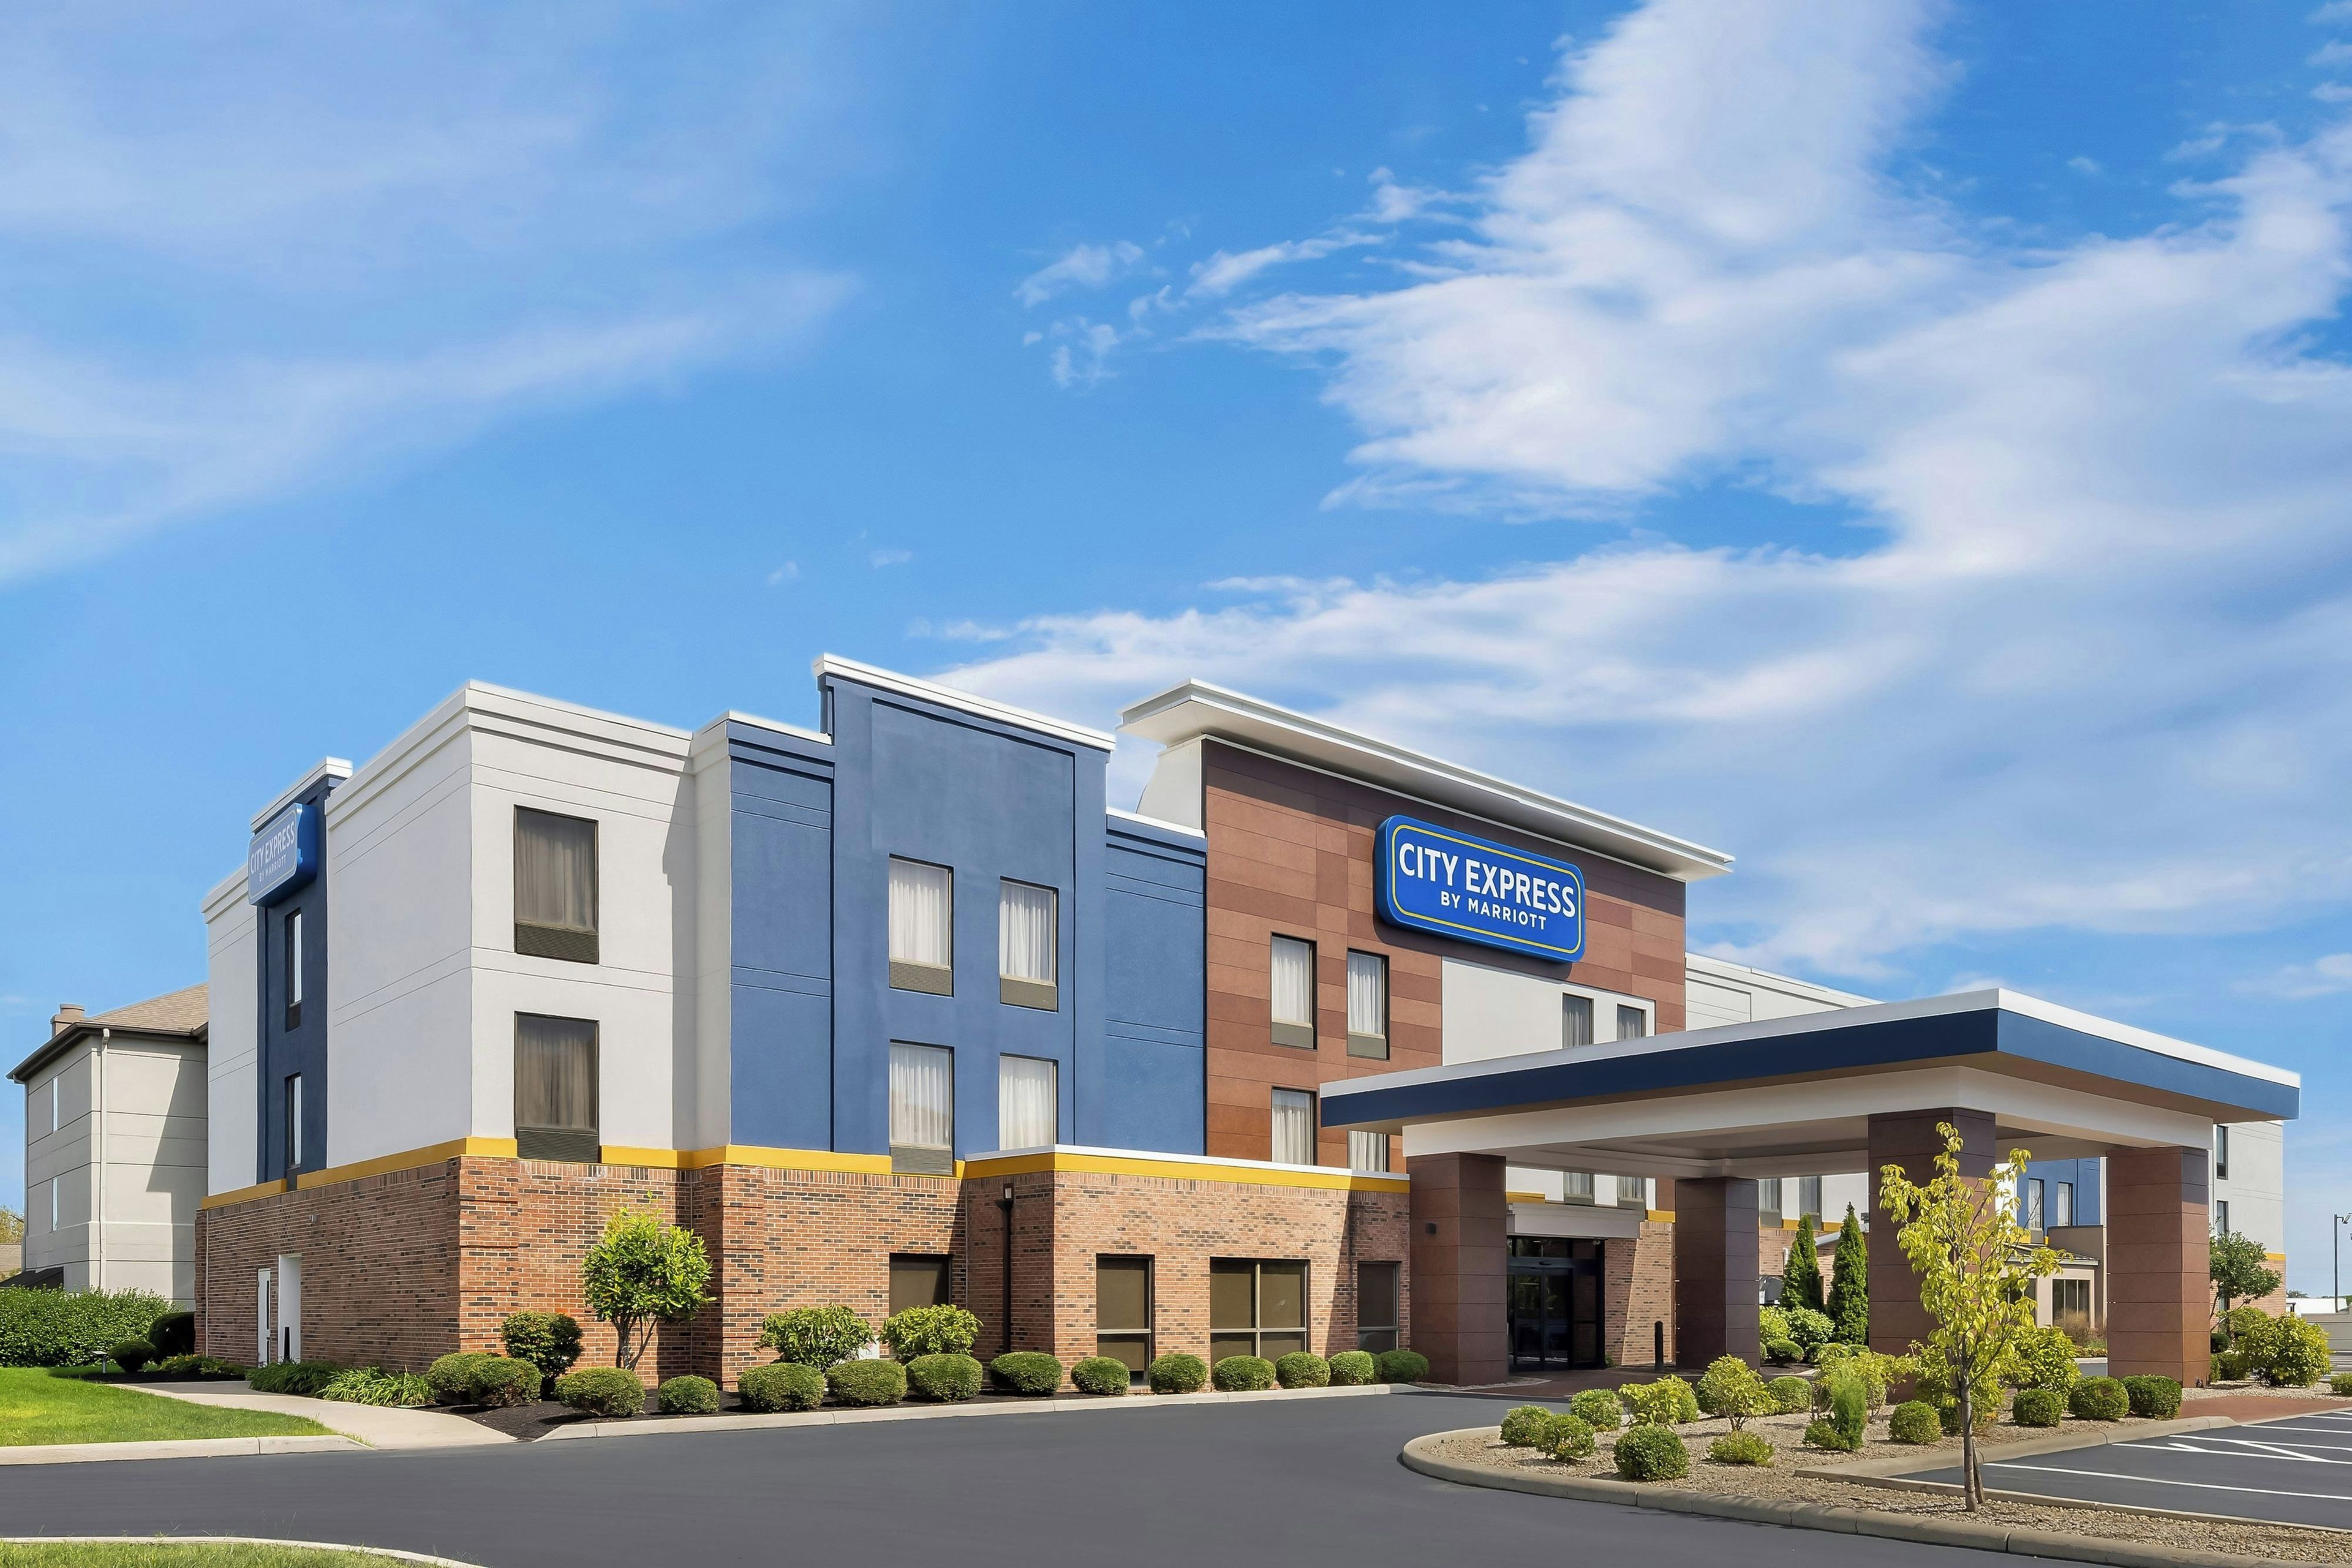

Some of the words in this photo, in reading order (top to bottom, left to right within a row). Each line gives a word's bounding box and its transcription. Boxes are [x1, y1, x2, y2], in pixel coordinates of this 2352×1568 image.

[251, 845, 264, 875] CITY
[265, 821, 294, 864] EXPRESS
[259, 872, 264, 882] BY
[265, 854, 286, 877] MARRIOTT
[1399, 843, 1458, 886] CITY
[1466, 859, 1576, 918] EXPRESS
[1441, 891, 1461, 908] BY
[1468, 898, 1547, 930] MARRIOTT
